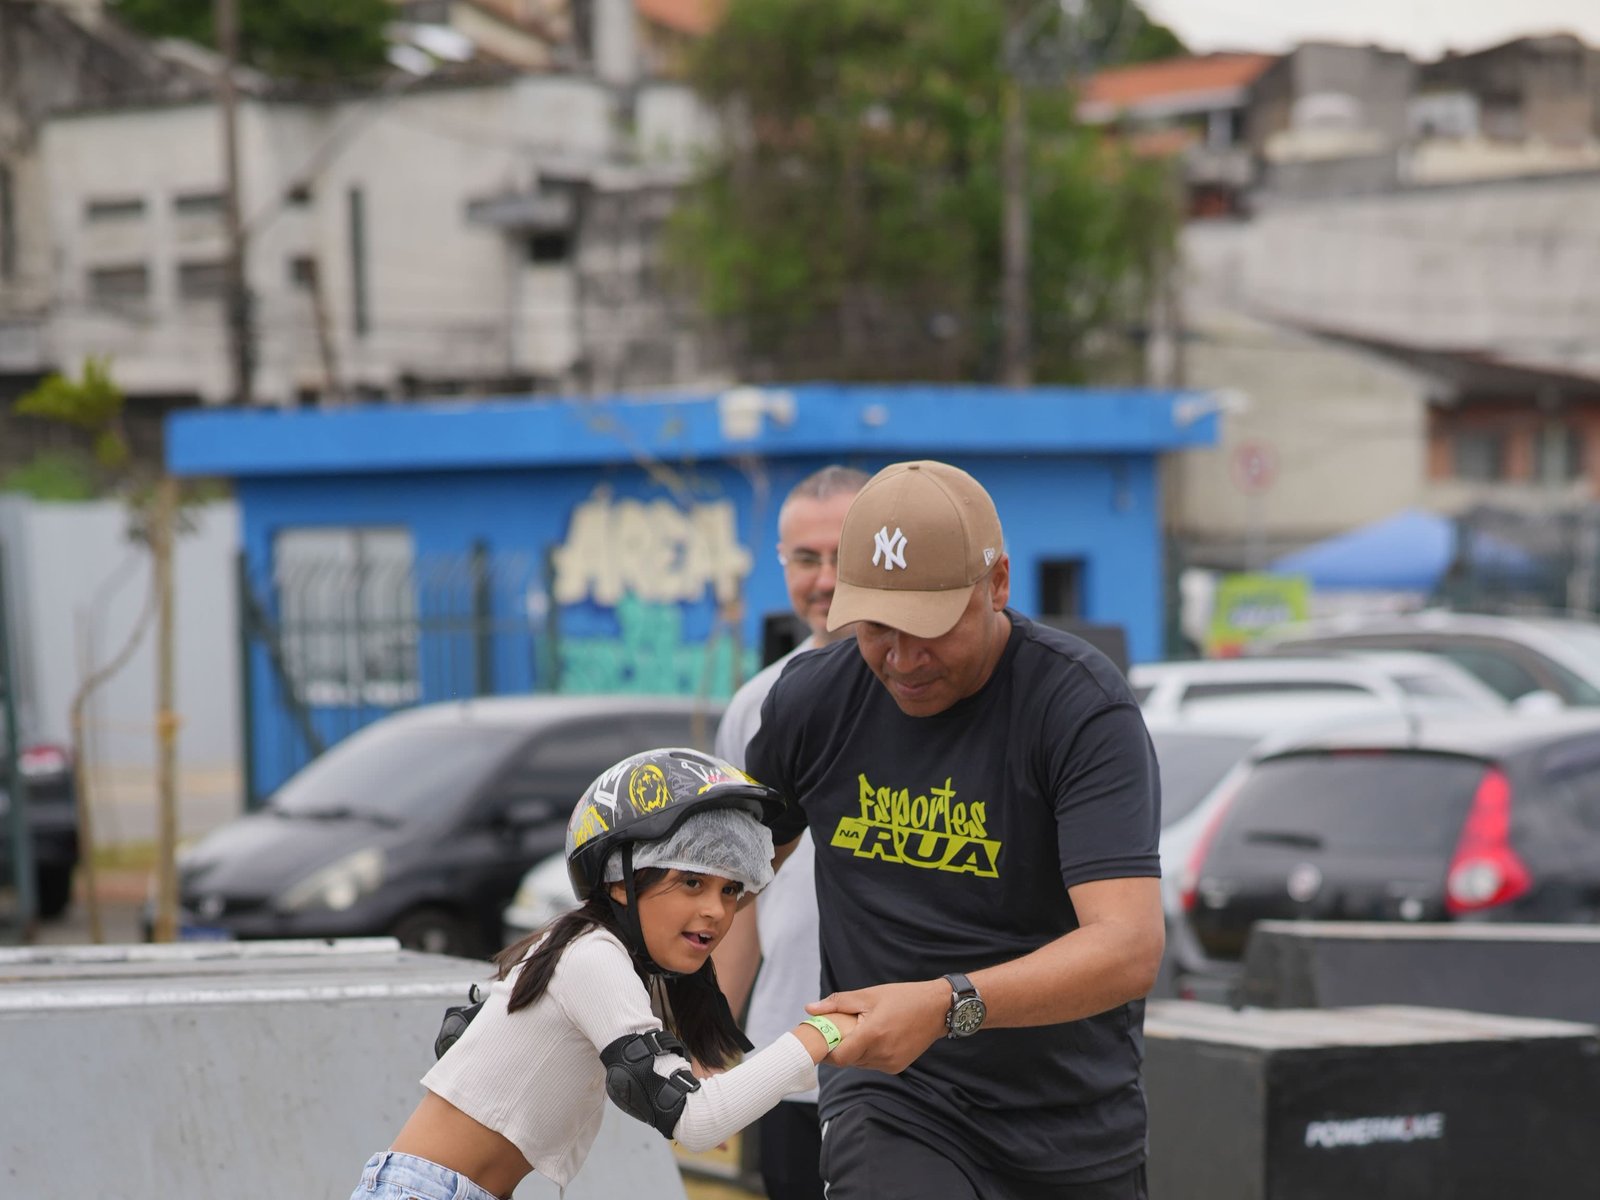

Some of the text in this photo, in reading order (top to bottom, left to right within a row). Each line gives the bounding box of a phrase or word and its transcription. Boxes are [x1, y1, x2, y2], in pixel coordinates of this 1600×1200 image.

[872, 526, 908, 570] NY
[858, 773, 988, 838] Esportes
[839, 824, 998, 876] NA RUA
